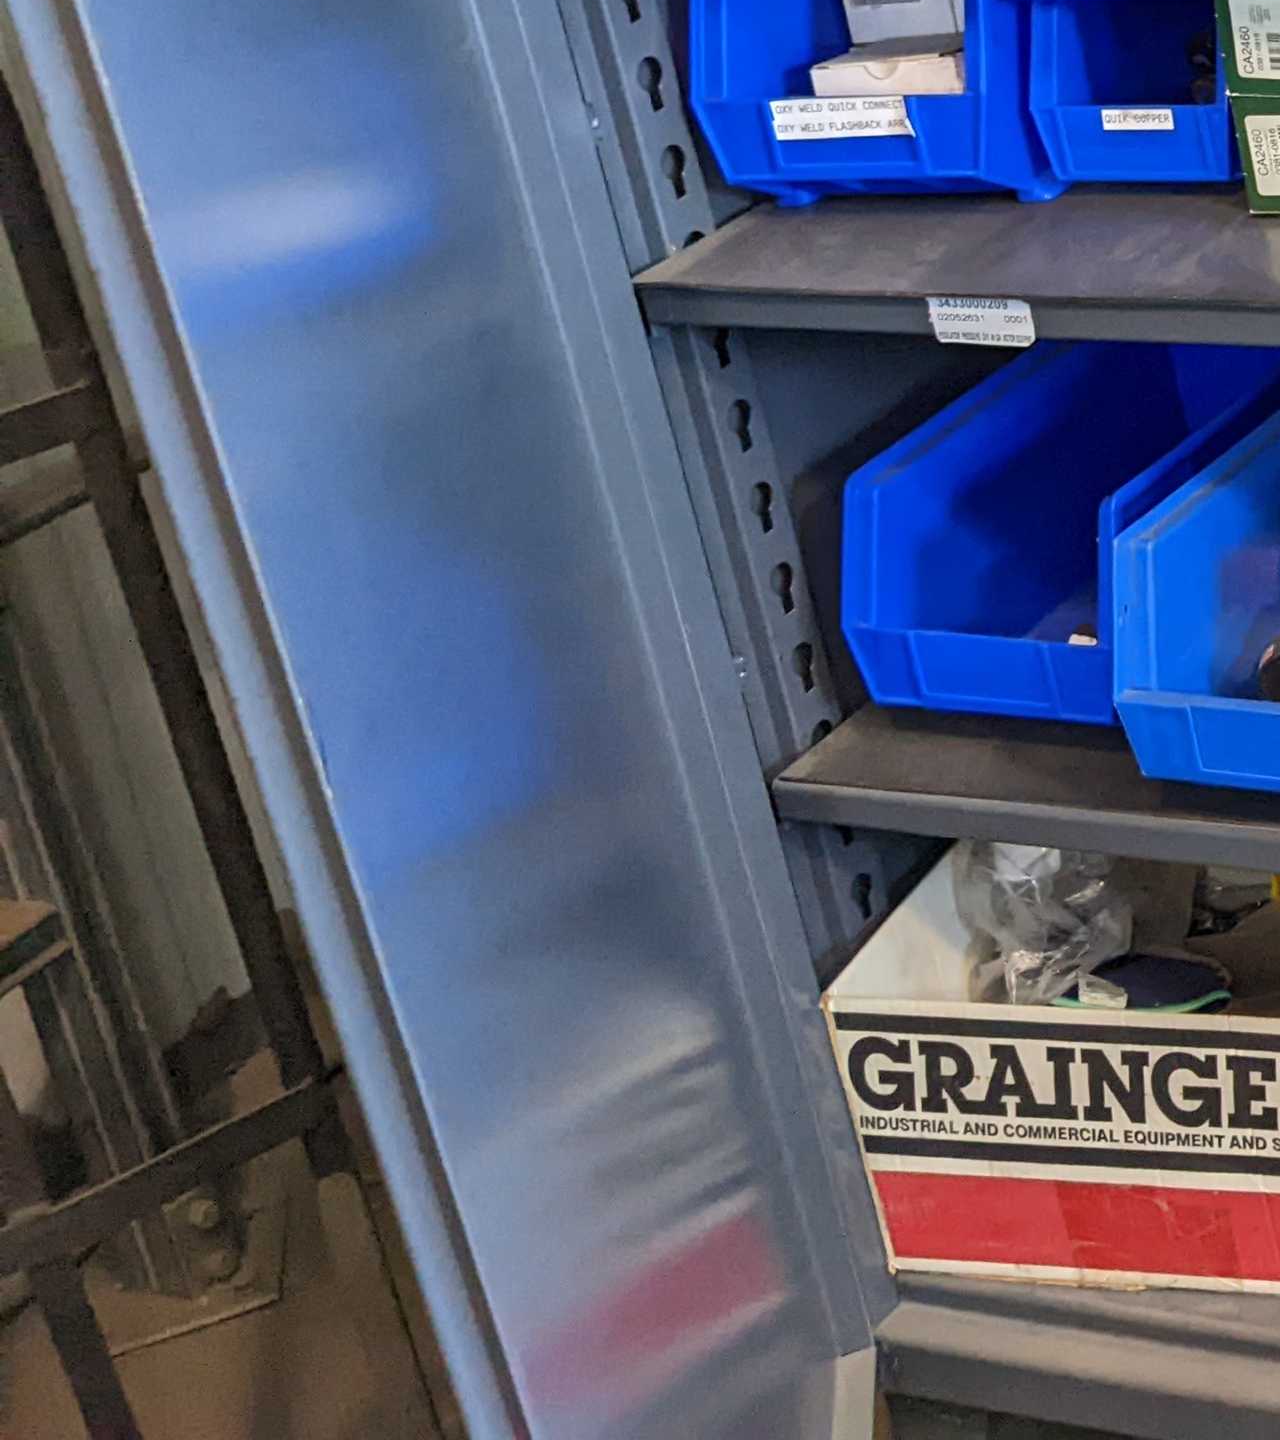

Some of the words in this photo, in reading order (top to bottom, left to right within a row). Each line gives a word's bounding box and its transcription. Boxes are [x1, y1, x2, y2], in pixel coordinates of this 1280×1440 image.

[1240, 26, 1255, 75] CA2460
[827, 101, 856, 112] QUICK
[801, 122, 824, 133] WELD
[829, 120, 881, 132] FLASHBACK
[1252, 129, 1269, 177] CA2460
[860, 1115, 959, 1136] INDUSTRIAL
[963, 1120, 997, 1137] AND
[1004, 1123, 1120, 1144] COMMERCIAL
[1124, 1129, 1225, 1150] EQUIPMENT
[1230, 1133, 1267, 1151] AND
